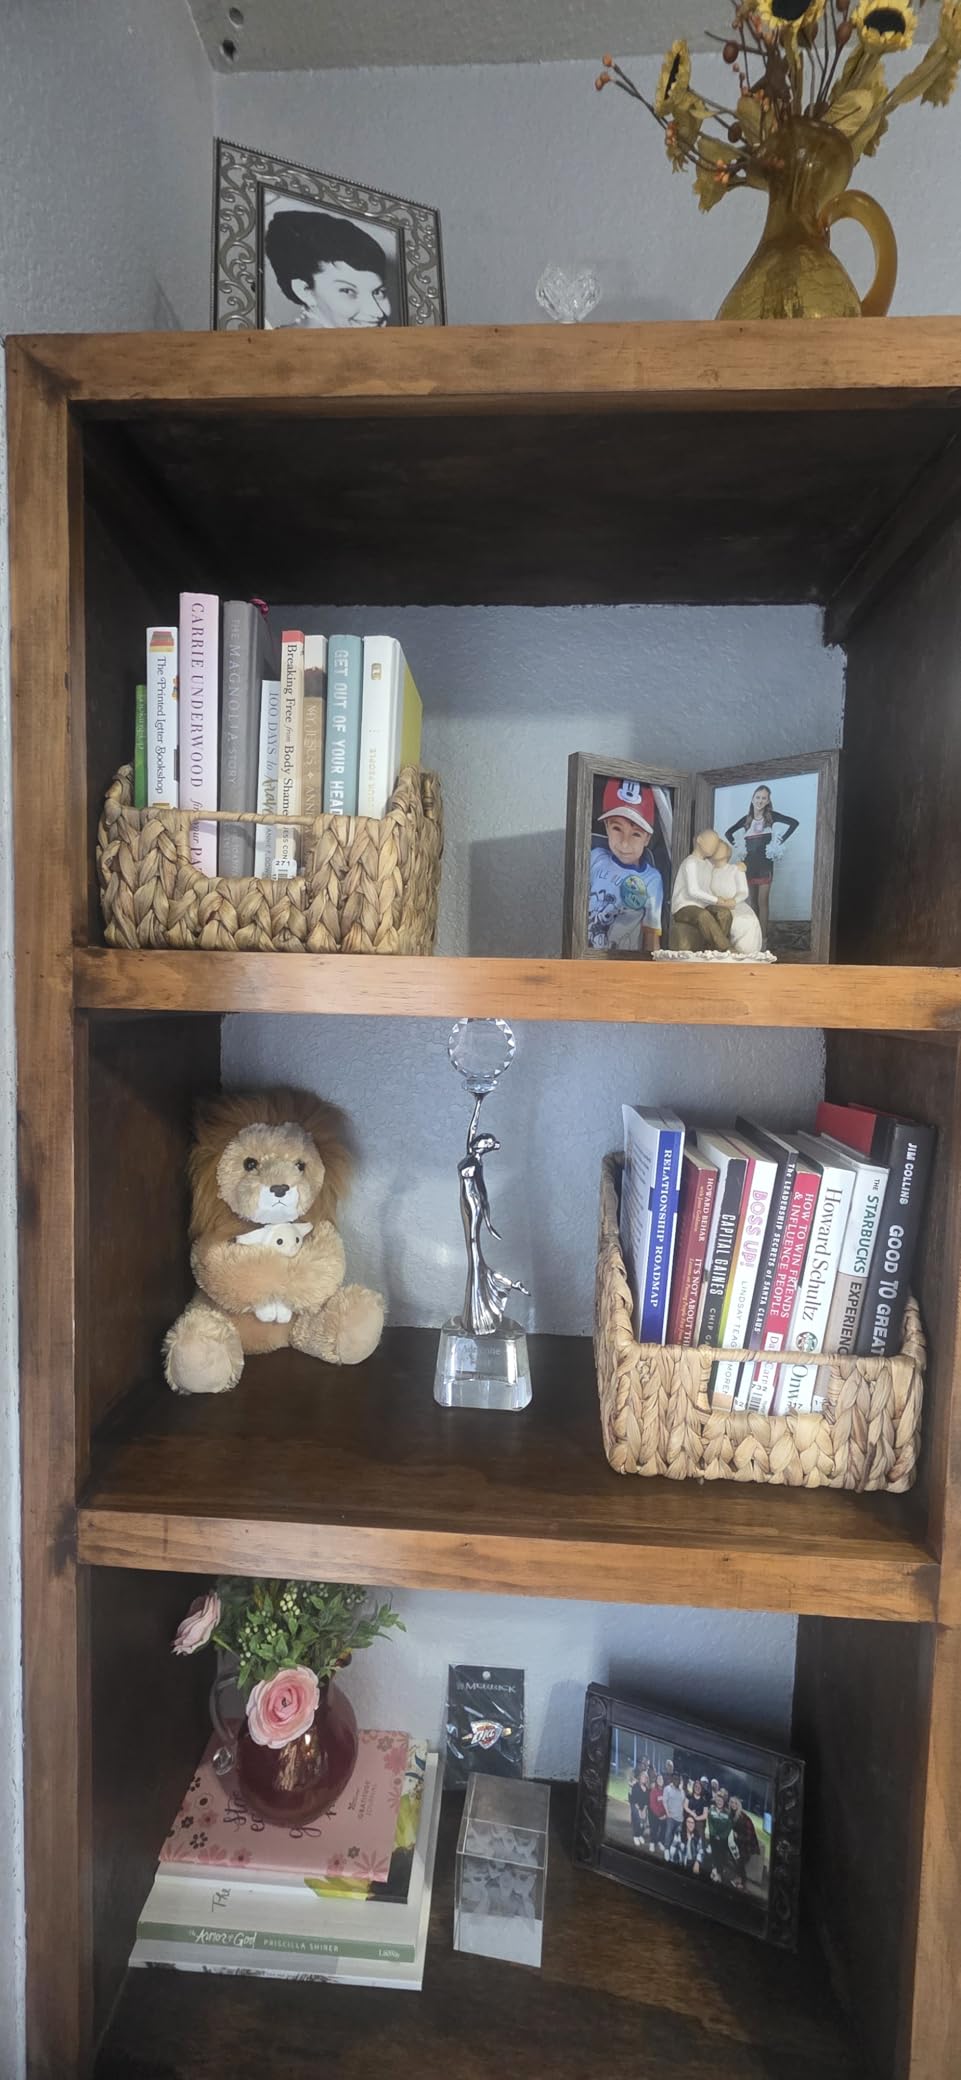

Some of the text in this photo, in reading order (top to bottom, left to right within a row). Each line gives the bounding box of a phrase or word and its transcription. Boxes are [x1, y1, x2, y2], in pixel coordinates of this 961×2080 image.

[191, 602, 204, 668] CARRIE
[157, 656, 167, 675] The
[283, 644, 297, 694] Breaking
[334, 650, 349, 676] GET
[157, 678, 167, 717] Printed
[227, 644, 241, 741] MAGNOLIA
[267, 692, 280, 716] 100
[332, 683, 348, 709] OUT
[285, 698, 296, 723] Free
[331, 716, 346, 733] OF
[190, 676, 204, 788] UNDERWOOD
[266, 721, 279, 755] DAYS
[154, 746, 166, 794] Bookshop
[227, 748, 239, 784] STORY
[281, 745, 295, 775] Body
[330, 739, 346, 774] YOUR
[281, 778, 294, 816] Shame
[872, 1179, 881, 1191] THE
[899, 1142, 918, 1206] JIM COLLINS
[698, 1178, 714, 1242] HOWARD BEHAR
[776, 1178, 792, 1230] LEADERSHIP
[650, 1149, 673, 1308] RELATIONSHIP ROADMAP
[854, 1195, 880, 1274] STARBUCKS
[709, 1214, 736, 1296] CAPITAL GAINES
[767, 1233, 782, 1266] SECRETS
[769, 1191, 804, 1316] & INFLUENCE PEOPLE
[780, 1193, 815, 1319] HOW TO WIN FRIENDS
[801, 1187, 844, 1321] Howard Schultz
[690, 1276, 700, 1296] NOT
[735, 1281, 749, 1320] LINDSAY
[759, 1281, 772, 1307] SANTA
[870, 1224, 905, 1356] GOOD TO GREAT
[685, 1297, 697, 1328] ABOUT
[706, 1308, 717, 1331] CHIP
[753, 1308, 766, 1333] CLAUS
[211, 1887, 231, 1912] The
[233, 1931, 257, 1949] God
[263, 1938, 306, 1951] PRISCILLA
